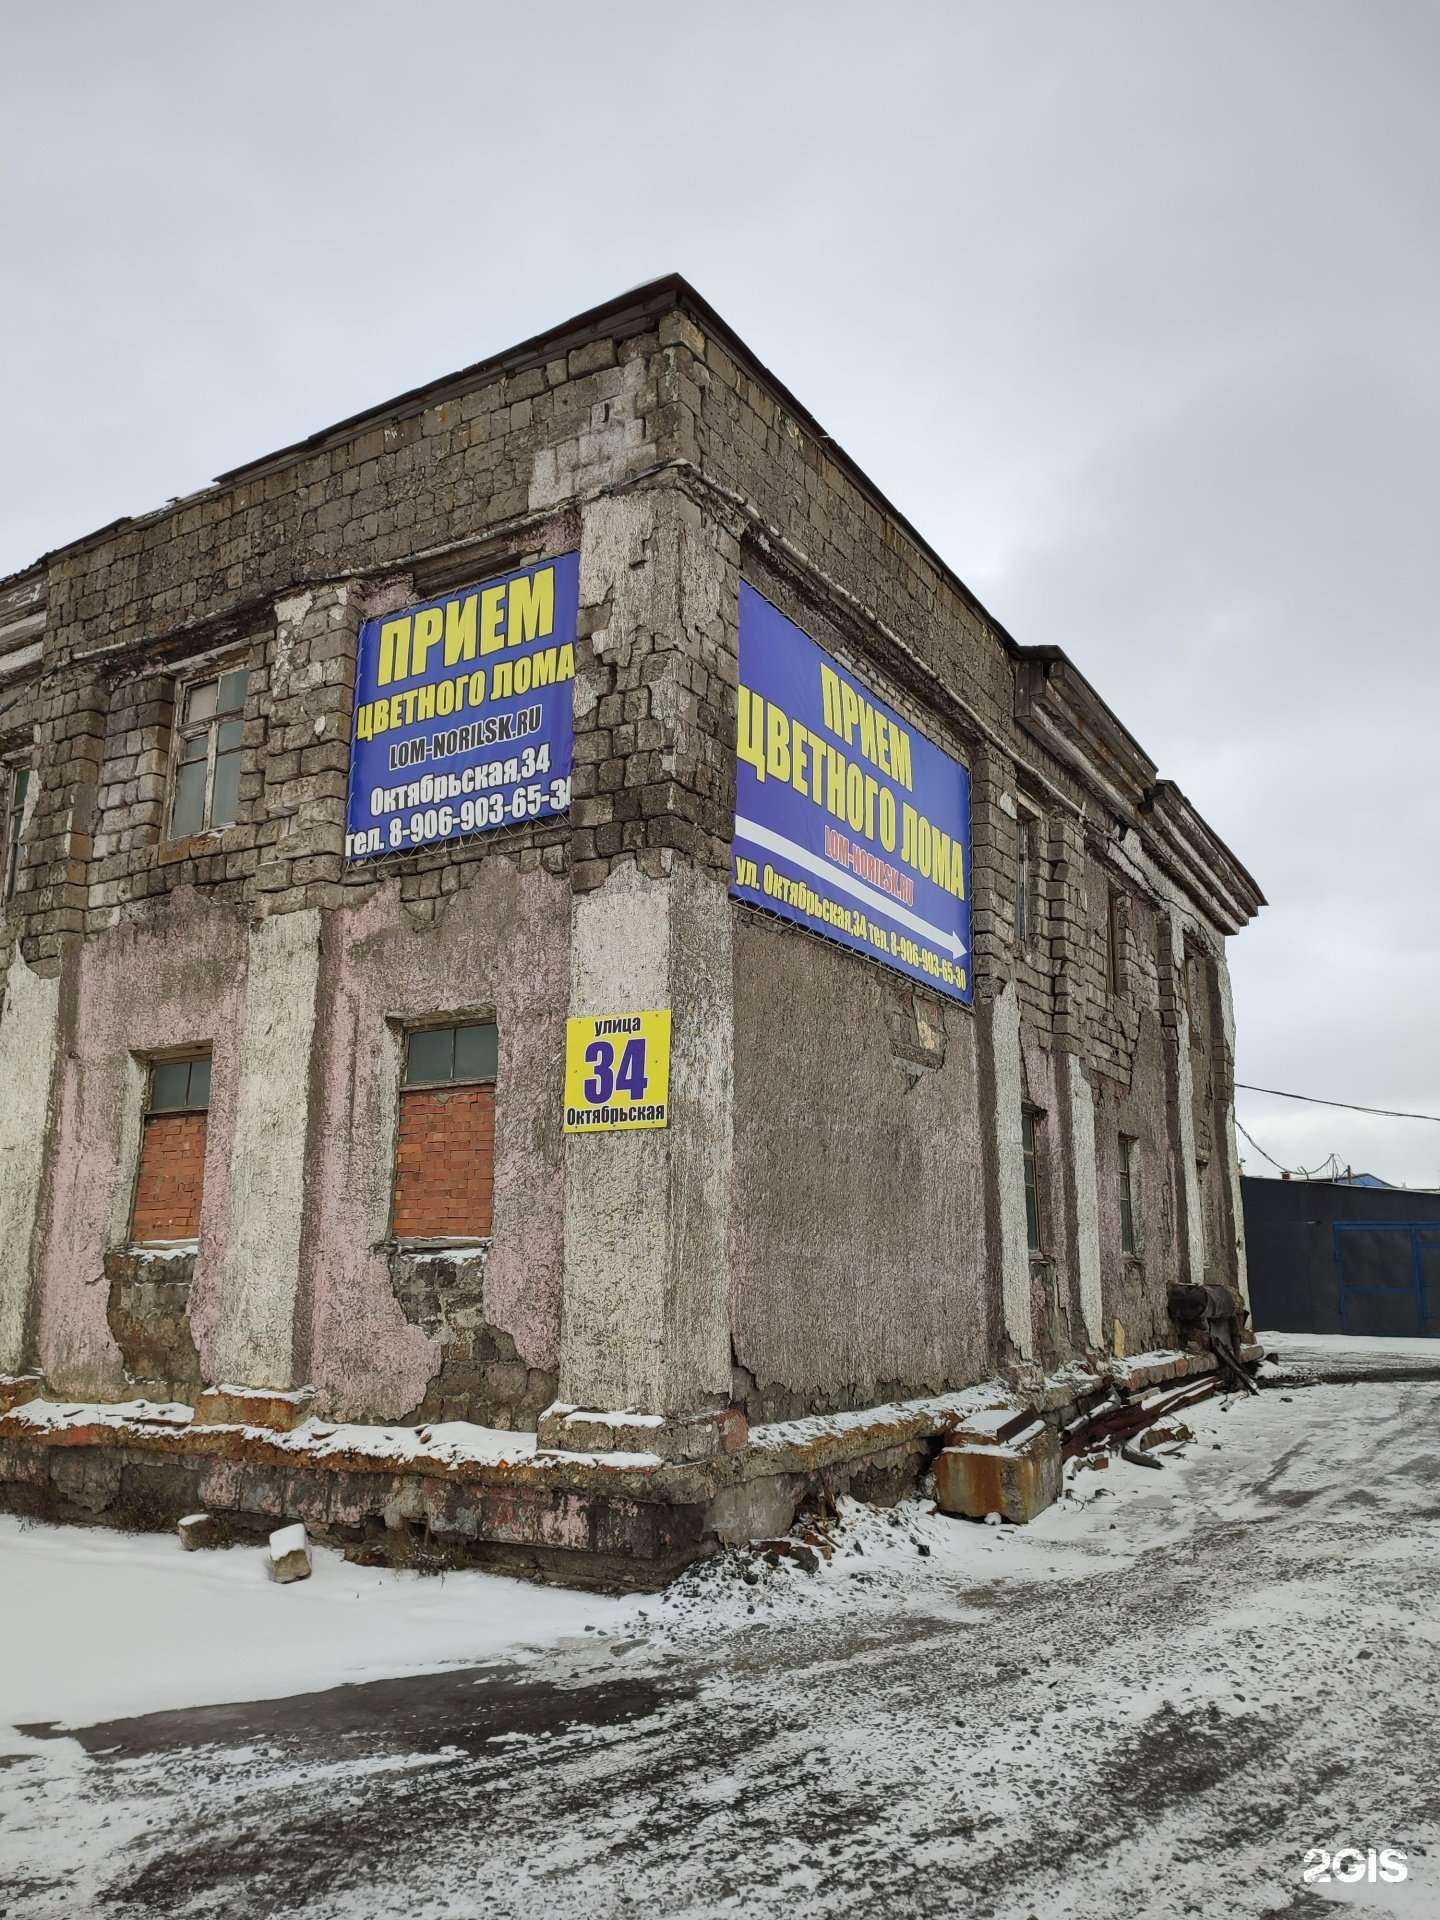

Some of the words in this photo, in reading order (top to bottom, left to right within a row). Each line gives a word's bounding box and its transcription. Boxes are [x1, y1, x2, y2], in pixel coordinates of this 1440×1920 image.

[377, 567, 555, 686] ПРИЕМ
[357, 669, 486, 742] ЦВЕТНОГО
[490, 642, 576, 701] ЛОМА
[819, 662, 914, 792] ПРИЕМ
[370, 743, 551, 816] Октябрьская,34
[388, 704, 543, 770] LOM-NORILSK.RU
[737, 684, 897, 853] ЦВЕТНОГО
[900, 801, 965, 901] ЛОМА
[735, 856, 760, 890] ул.
[763, 863, 868, 941] Октябрьская,34
[867, 921, 890, 954] тел.
[890, 931, 967, 991] 8-906-903-65-30
[594, 1017, 641, 1037] улица
[584, 1038, 648, 1104] 34
[566, 1104, 665, 1126] Октябрьская
